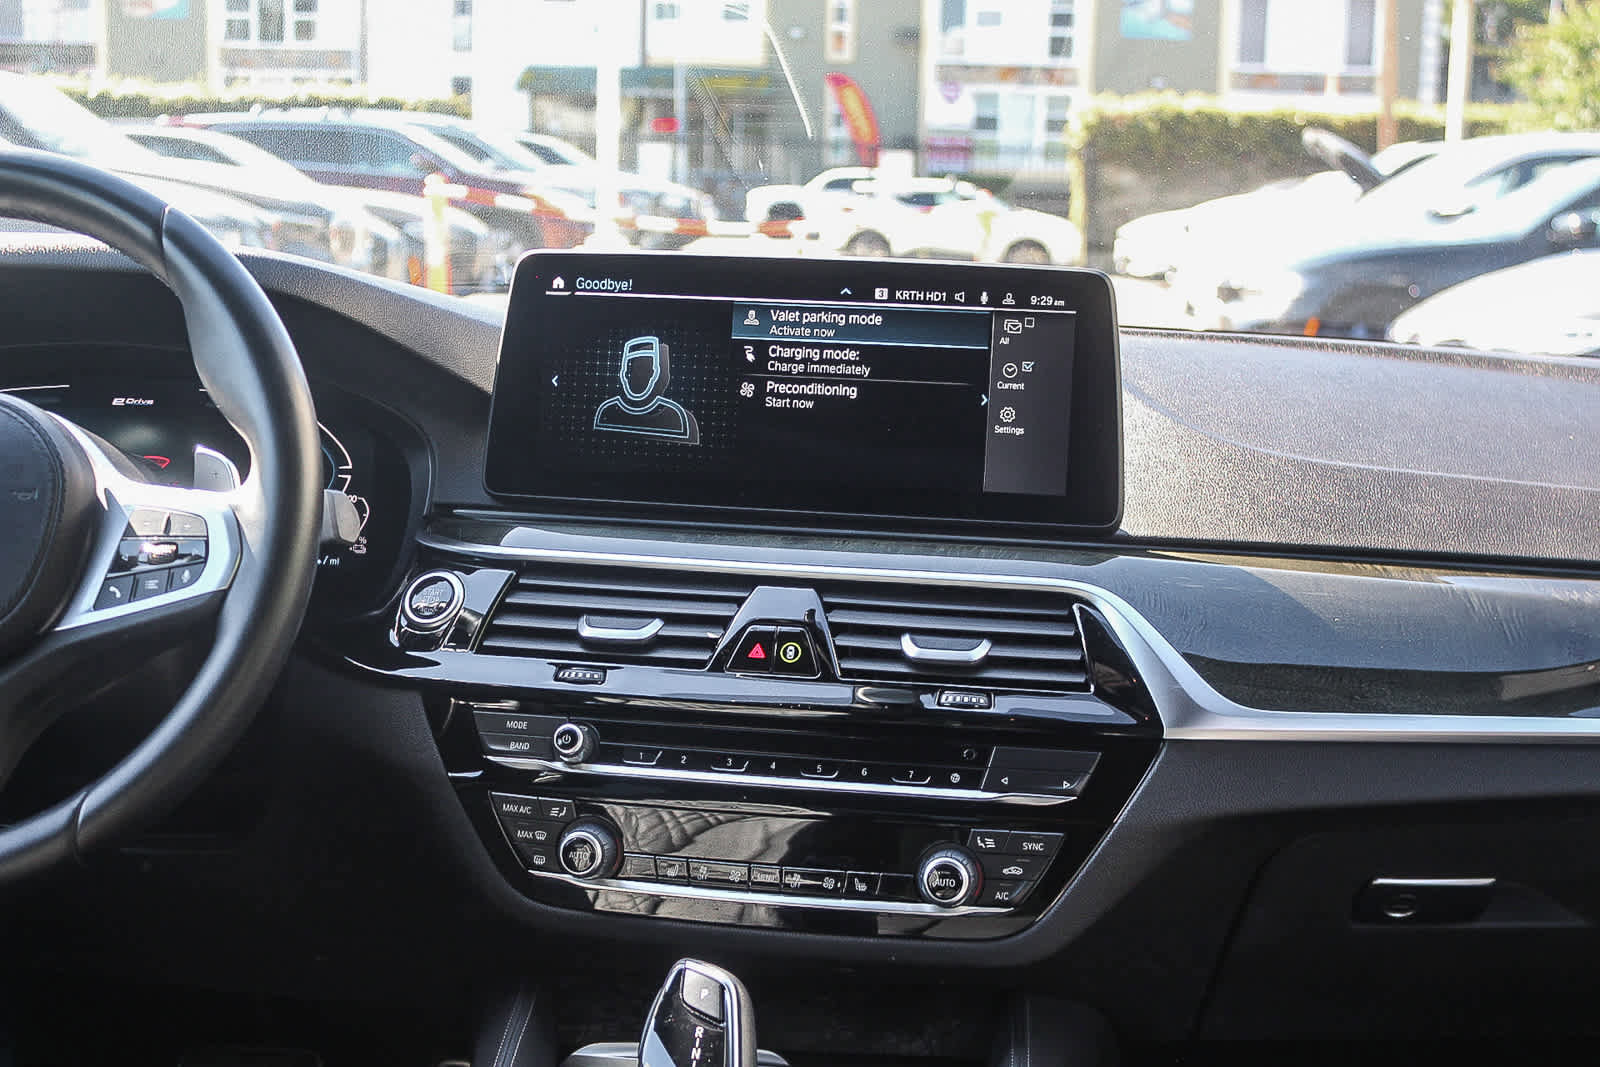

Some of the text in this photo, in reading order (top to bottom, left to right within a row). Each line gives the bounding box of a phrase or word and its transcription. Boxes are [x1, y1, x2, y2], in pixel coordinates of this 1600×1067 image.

[575, 277, 633, 292] Goodbye!
[895, 290, 947, 301] KRTH HD1
[1030, 296, 1053, 306] 9:29
[770, 309, 883, 327] Valet parking mode
[769, 325, 836, 337] Activate now
[768, 345, 860, 361] Charging mode:
[767, 360, 871, 378] Charge immediately
[766, 380, 858, 399] Preconditioning
[997, 381, 1025, 391] Current
[765, 396, 814, 409] Start now
[994, 425, 1025, 435] Settings
[506, 720, 528, 730] MODE
[509, 741, 530, 750] BAND
[680, 755, 687, 764] 2
[726, 758, 733, 766] 3
[770, 761, 776, 770] 4
[816, 765, 823, 773] 5
[861, 767, 868, 777] 6
[907, 770, 915, 779] 7
[502, 803, 532, 814] MAX A/C
[516, 829, 534, 839] MAX
[1022, 842, 1044, 851] SYNC
[936, 878, 956, 888] AUTO
[995, 892, 1009, 900] A/C
[701, 989, 709, 1000] P
[691, 1026, 704, 1060] R N
